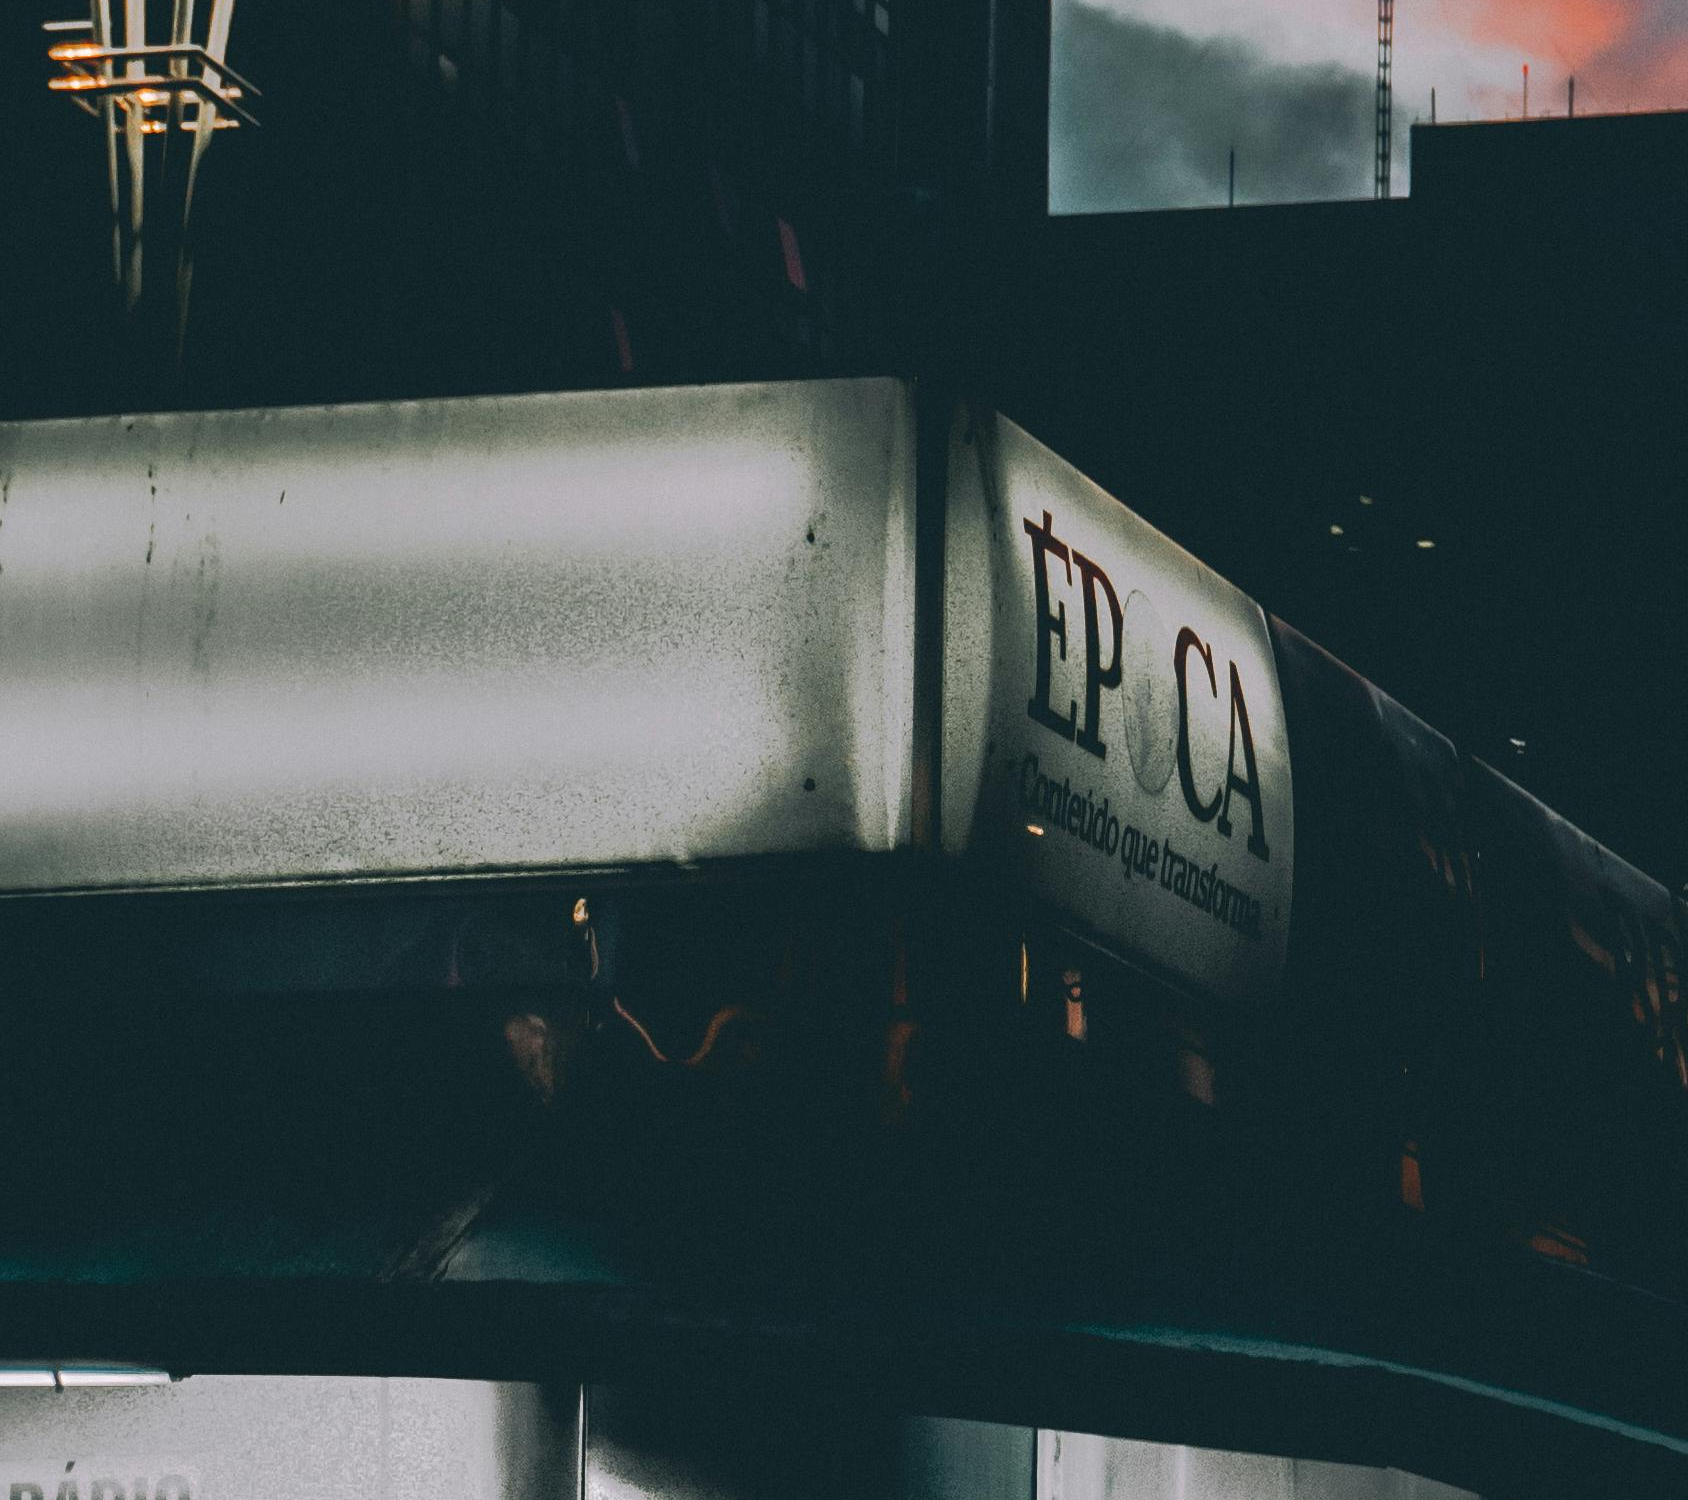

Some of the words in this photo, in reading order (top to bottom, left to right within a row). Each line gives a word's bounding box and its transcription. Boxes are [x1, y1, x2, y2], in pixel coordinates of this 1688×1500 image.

[1020, 754, 1119, 857] Conteúdo
[1121, 823, 1159, 882] que
[1160, 838, 1262, 940] transforma
